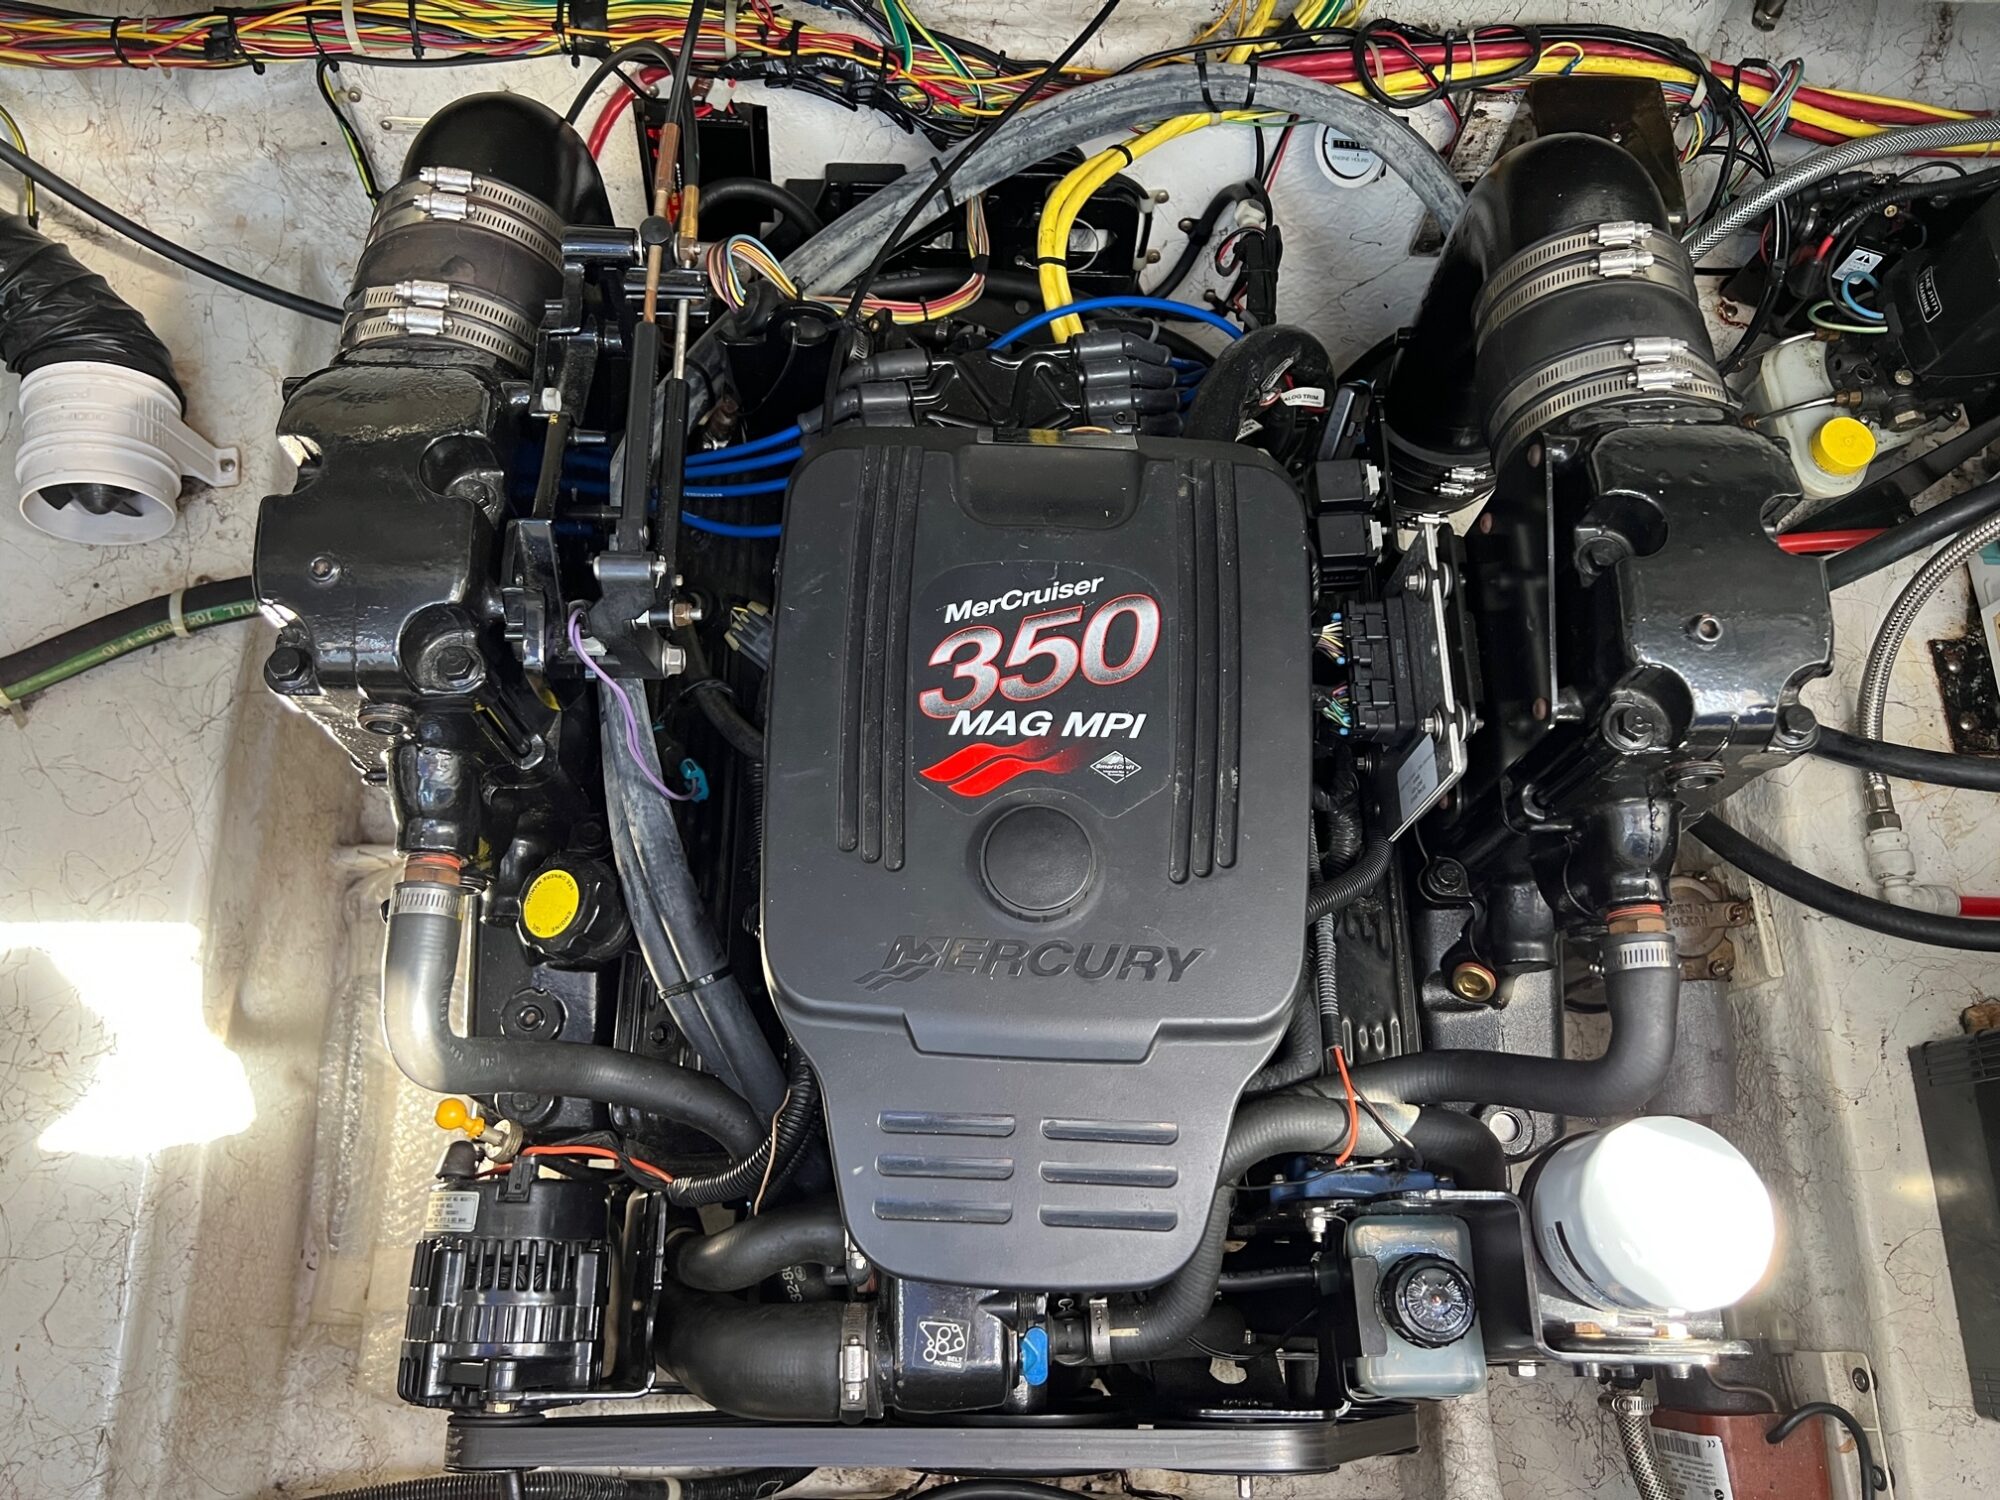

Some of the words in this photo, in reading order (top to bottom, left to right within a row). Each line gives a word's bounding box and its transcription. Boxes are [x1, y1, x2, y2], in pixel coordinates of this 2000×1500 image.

[1919, 281, 1931, 314] MARINE
[1305, 392, 1320, 401] TRIM
[944, 576, 1105, 624] MerCruiser
[918, 593, 1161, 720] 350
[948, 709, 1054, 737] MAG
[1061, 711, 1148, 739] MPI
[866, 934, 1206, 987] MERCURY
[933, 1360, 962, 1369] ROUTING
[946, 1355, 963, 1363] BELT
